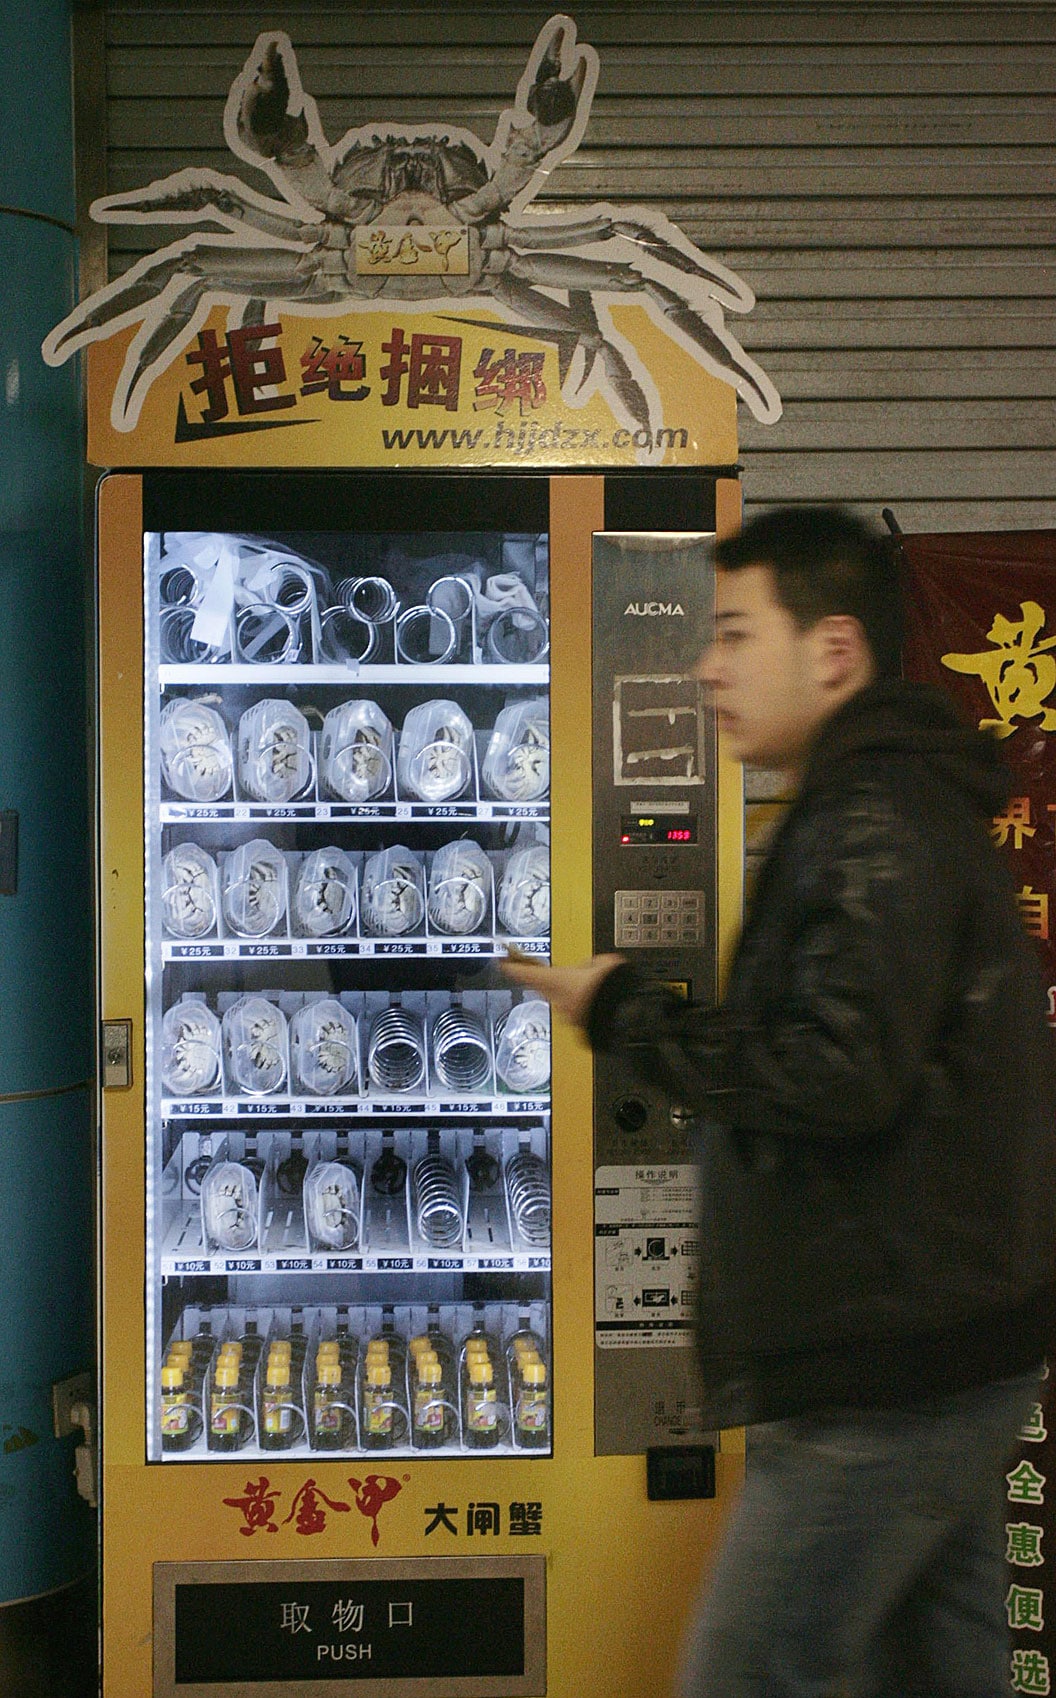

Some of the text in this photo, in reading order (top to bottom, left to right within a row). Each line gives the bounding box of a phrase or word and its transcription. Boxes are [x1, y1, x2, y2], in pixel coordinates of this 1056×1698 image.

[185, 322, 548, 422] 拒绝捆绑
[624, 602, 685, 616] AUCMA
[940, 601, 1056, 739] 黄
[989, 797, 1056, 849] 界
[222, 1474, 543, 1547] 黄金甲 大闸蟹
[279, 1599, 414, 1634] 取物口
[317, 1644, 372, 1661] PUSH
